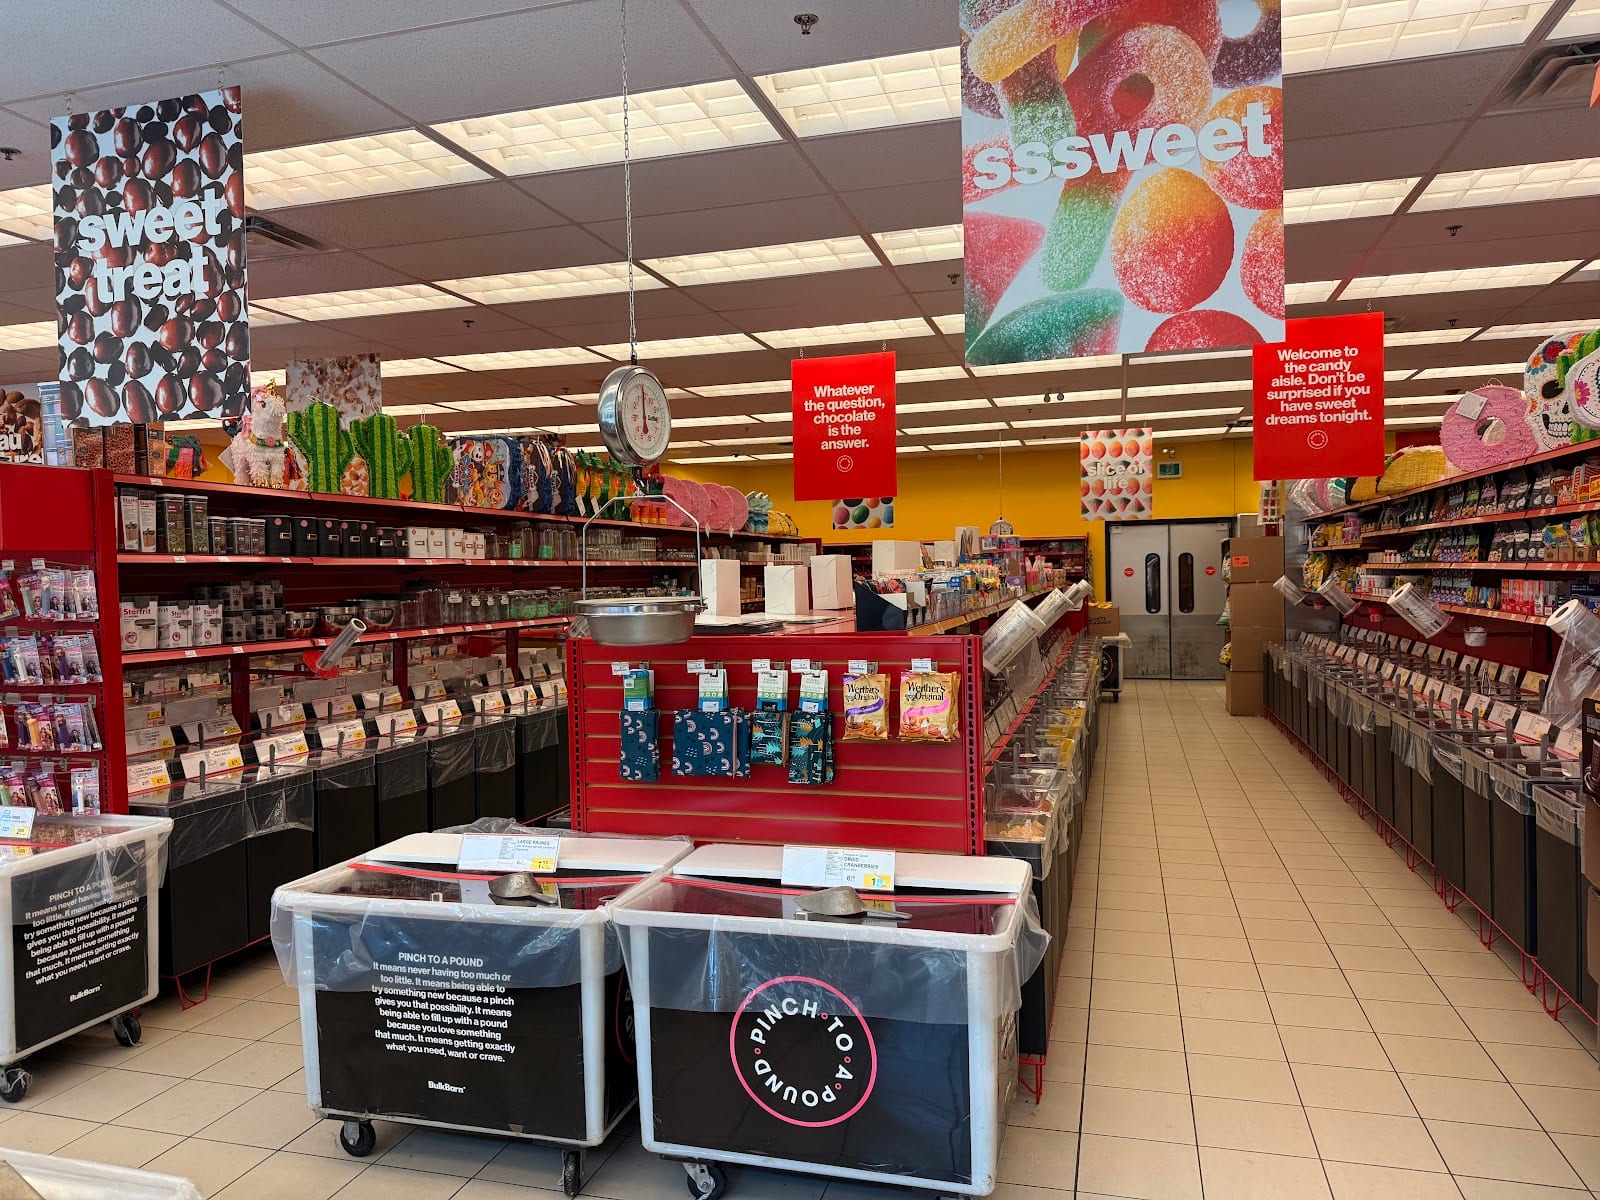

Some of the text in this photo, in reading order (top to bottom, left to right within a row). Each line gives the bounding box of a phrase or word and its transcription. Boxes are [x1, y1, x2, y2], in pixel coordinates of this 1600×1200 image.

[973, 101, 1272, 190] sssweet
[78, 188, 221, 252] sweet
[93, 246, 210, 304] treat
[1277, 346, 1358, 361] Welcome to
[1284, 359, 1351, 373] the candy
[1271, 371, 1365, 387] aisle. Don't be
[814, 384, 875, 398] Whatever
[1266, 385, 1370, 401] surprised if you
[804, 396, 885, 412] the question,
[1280, 397, 1356, 412] have sweet
[813, 410, 876, 425] chocolate
[1265, 409, 1372, 425] dreams tonight.
[828, 424, 861, 437] is the
[821, 438, 869, 450] answer.
[1088, 462, 1125, 476] slice
[1128, 461, 1145, 474] of
[1103, 476, 1129, 490] life
[907, 681, 946, 694] Werther's
[915, 692, 944, 702] Original
[49, 889, 74, 903] PINCH
[74, 885, 85, 896] TO
[86, 883, 92, 892] A
[24, 932, 35, 940] try
[36, 921, 75, 937] something
[75, 914, 90, 924] new
[90, 903, 118, 918] because
[122, 896, 139, 909] pinch
[25, 911, 31, 919] It
[32, 904, 57, 917] means
[58, 898, 77, 909] never
[32, 918, 45, 927] too
[46, 912, 65, 923] little.
[65, 909, 71, 917] It
[71, 902, 94, 916] means
[27, 906, 138, 950] gives you that possibility. It means
[31, 946, 52, 958] being
[53, 940, 69, 950] able
[77, 932, 86, 941] fill
[86, 931, 96, 939] up
[96, 925, 109, 935] with
[115, 915, 135, 929] pound
[26, 931, 140, 979] that much. It means getting exactly
[37, 927, 130, 965] because you love something
[35, 945, 132, 985] what you need, want or crave.
[398, 952, 484, 968] PINCH TO A POUND
[373, 961, 512, 982] It means never having too much or
[380, 974, 506, 993] too little. It means being able to
[371, 985, 515, 1006] try something new because a pinch
[374, 996, 512, 1018] gives you that possibility. It means
[379, 1008, 508, 1029] being able to fill up with a pound
[386, 1019, 502, 1041] because you love something
[374, 1029, 516, 1054] that much. It means getting exactly
[750, 997, 854, 1107] PINCH TO A POUND
[386, 1042, 506, 1063] what you need, want or crave.
